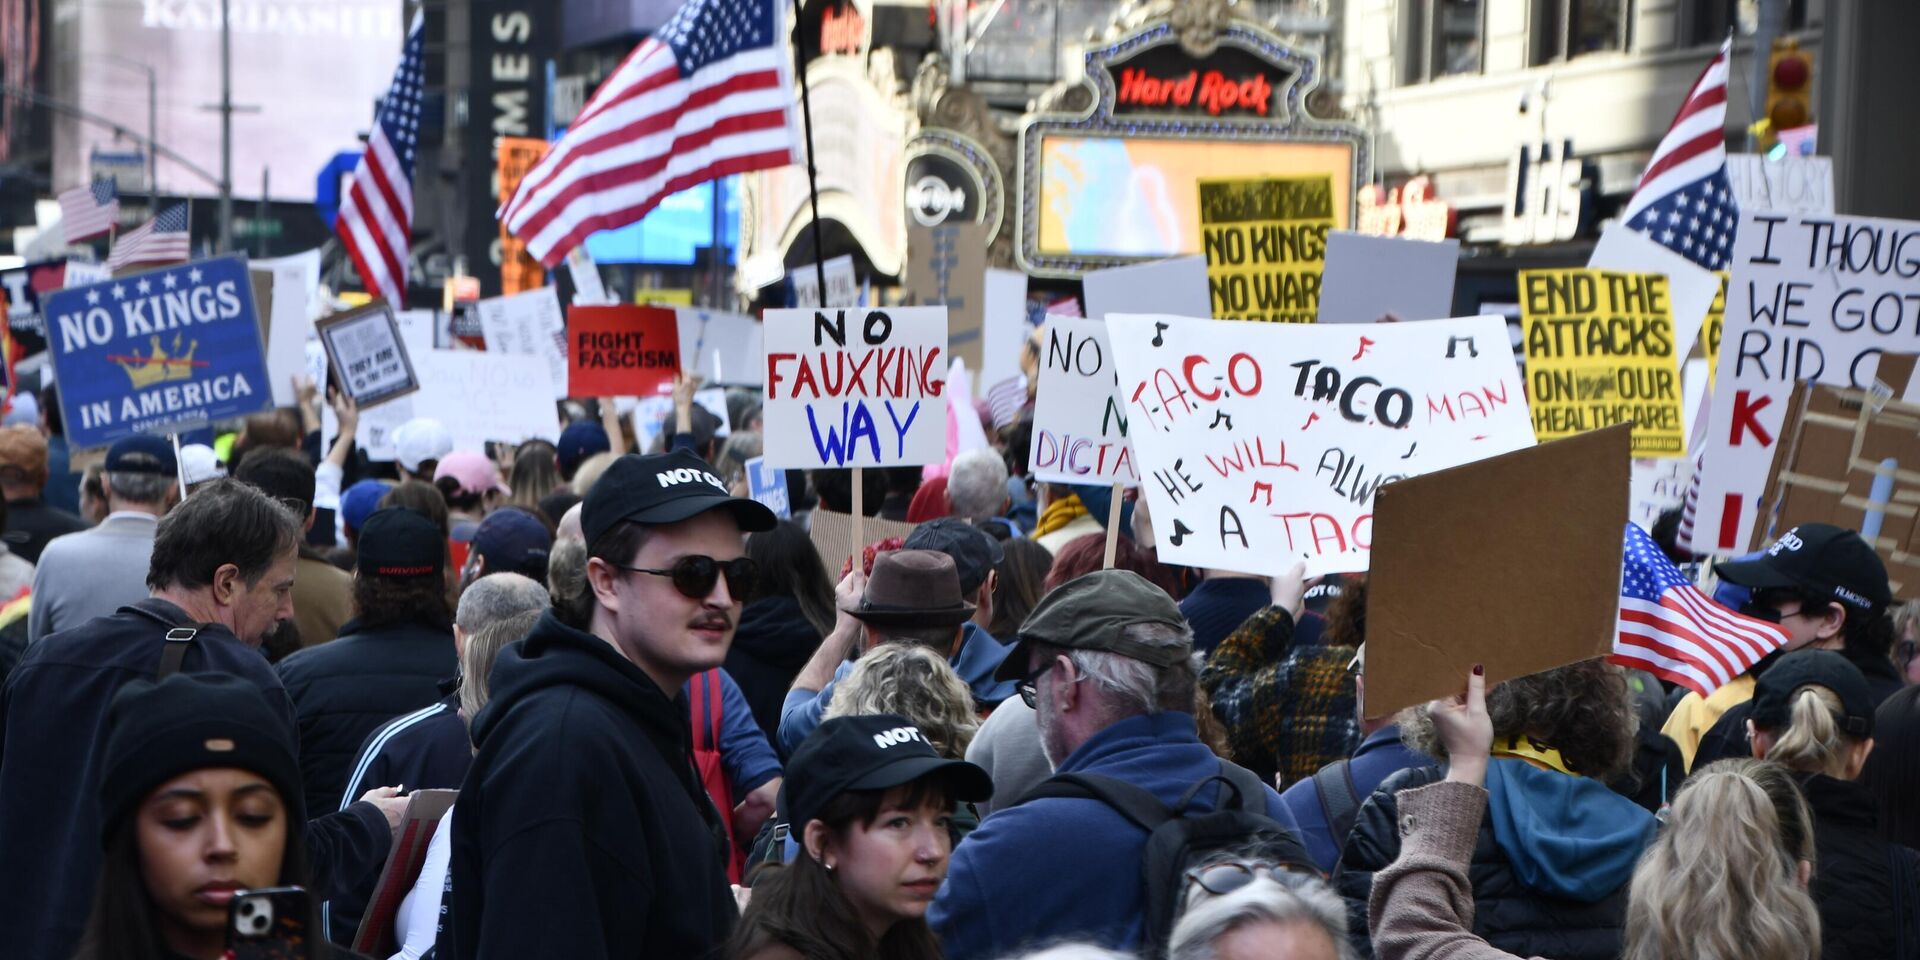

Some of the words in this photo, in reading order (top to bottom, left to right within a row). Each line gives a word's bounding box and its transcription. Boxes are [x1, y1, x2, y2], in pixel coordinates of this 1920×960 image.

[1119, 67, 1198, 105] Hard
[1198, 69, 1272, 117] Rock
[1203, 227, 1246, 267] NO
[1749, 216, 1788, 265] I
[1208, 273, 1250, 313] NO
[1251, 271, 1322, 310] WAR
[1525, 272, 1598, 317] END
[1600, 274, 1668, 316] THE
[1748, 279, 1814, 328] WE
[1831, 287, 1920, 337] GOT
[57, 306, 114, 354] NO
[120, 279, 242, 338] KINGS
[813, 309, 893, 348] NO
[1528, 316, 1674, 359] ATTACKS
[578, 331, 645, 350] FIGHT
[578, 350, 676, 369] FASCISM
[1048, 326, 1103, 377] NO
[1735, 329, 1826, 383] RID
[767, 345, 946, 400] FAUXKING
[1533, 368, 1576, 403] ON
[1617, 366, 1677, 401] OUR
[79, 400, 113, 430] IN
[119, 371, 253, 422] AMERICA
[1426, 378, 1509, 424] MAN
[1536, 403, 1680, 433] HEALTHCARE!
[804, 398, 922, 467] WAY
[656, 467, 702, 489] NOT
[1153, 457, 1204, 506] HE
[1204, 435, 1300, 479] WILL
[1315, 447, 1425, 507] ALW
[1219, 504, 1250, 550] A
[873, 726, 921, 749] NOT
